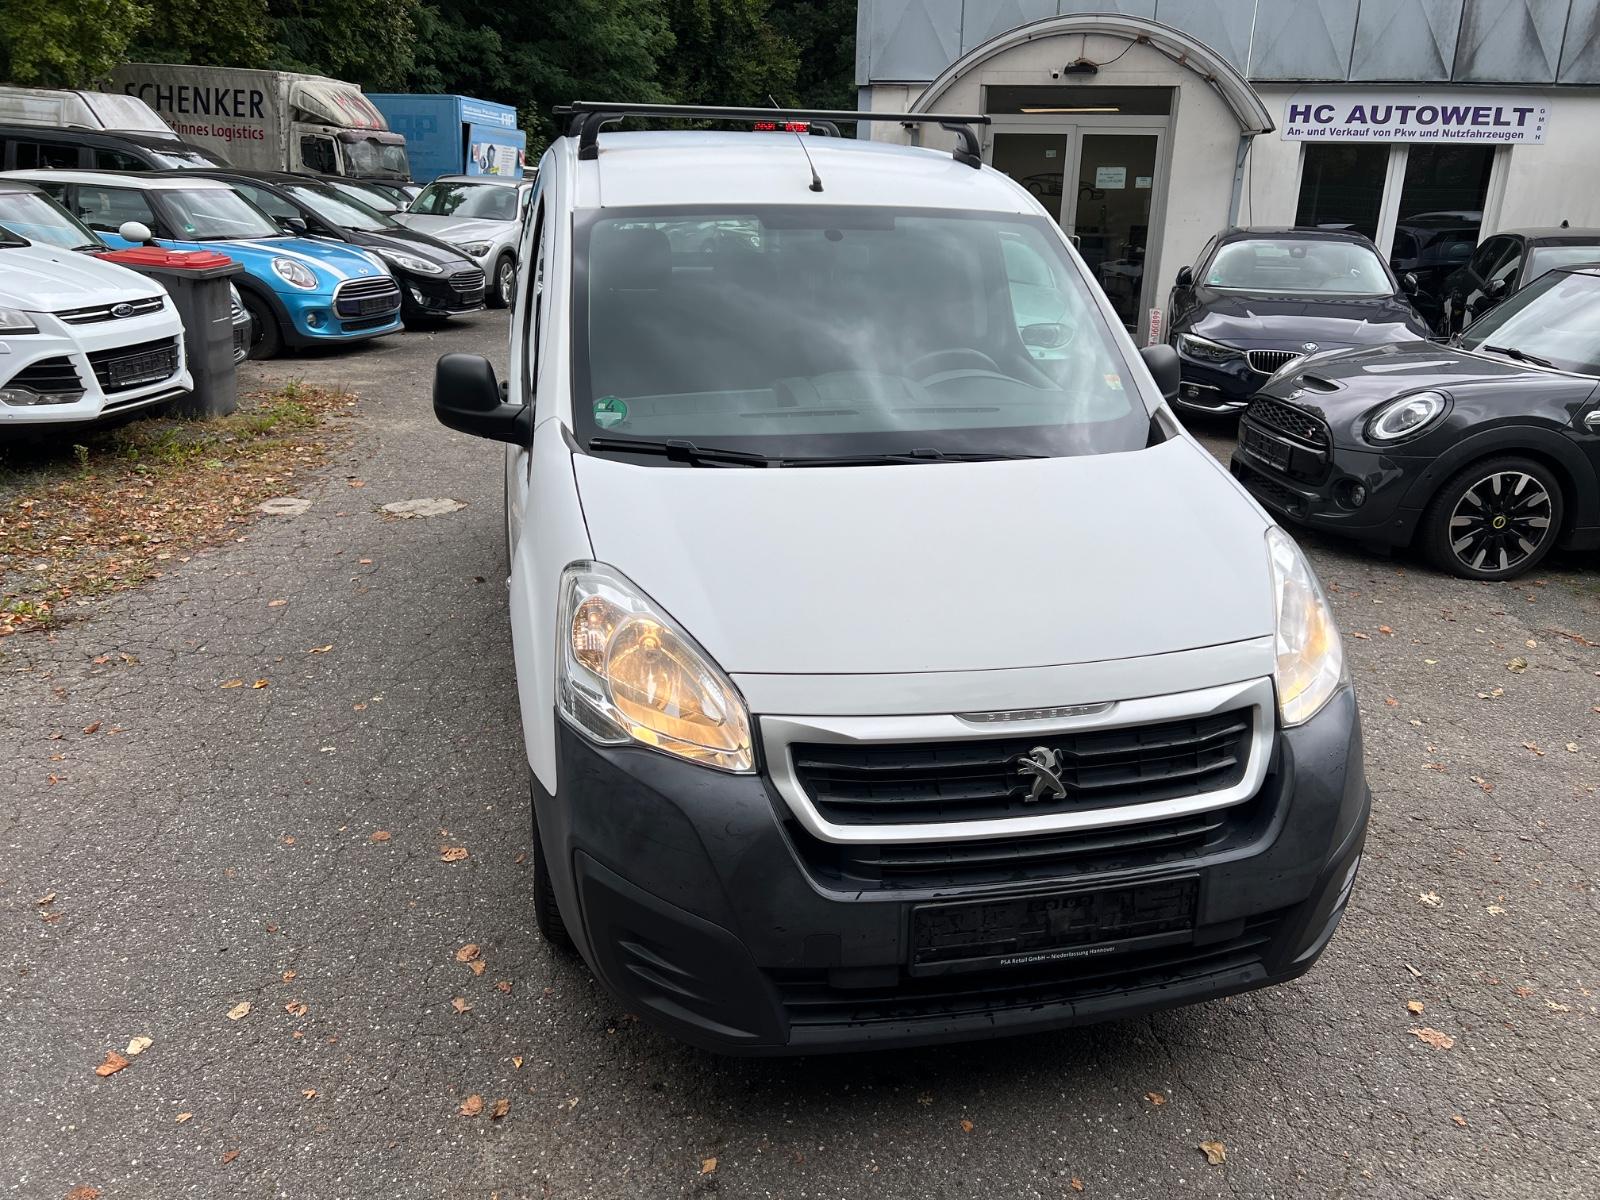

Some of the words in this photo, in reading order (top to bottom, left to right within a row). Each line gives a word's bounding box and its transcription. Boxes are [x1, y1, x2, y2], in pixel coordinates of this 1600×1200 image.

[1288, 104, 1335, 124] HC
[1344, 105, 1534, 127] AUTOWELT
[167, 120, 209, 136] tinnes
[211, 123, 264, 142] Logistics
[1287, 127, 1304, 136] An-
[1307, 127, 1326, 136] und
[1329, 127, 1370, 137] Verkauf
[1373, 129, 1391, 137] von
[1394, 128, 1416, 137] Pkw
[1419, 129, 1439, 137] und
[1442, 129, 1524, 140] Nutzfahrzeugen
[605, 399, 615, 412] 4
[1051, 950, 1089, 959] Niederlassung
